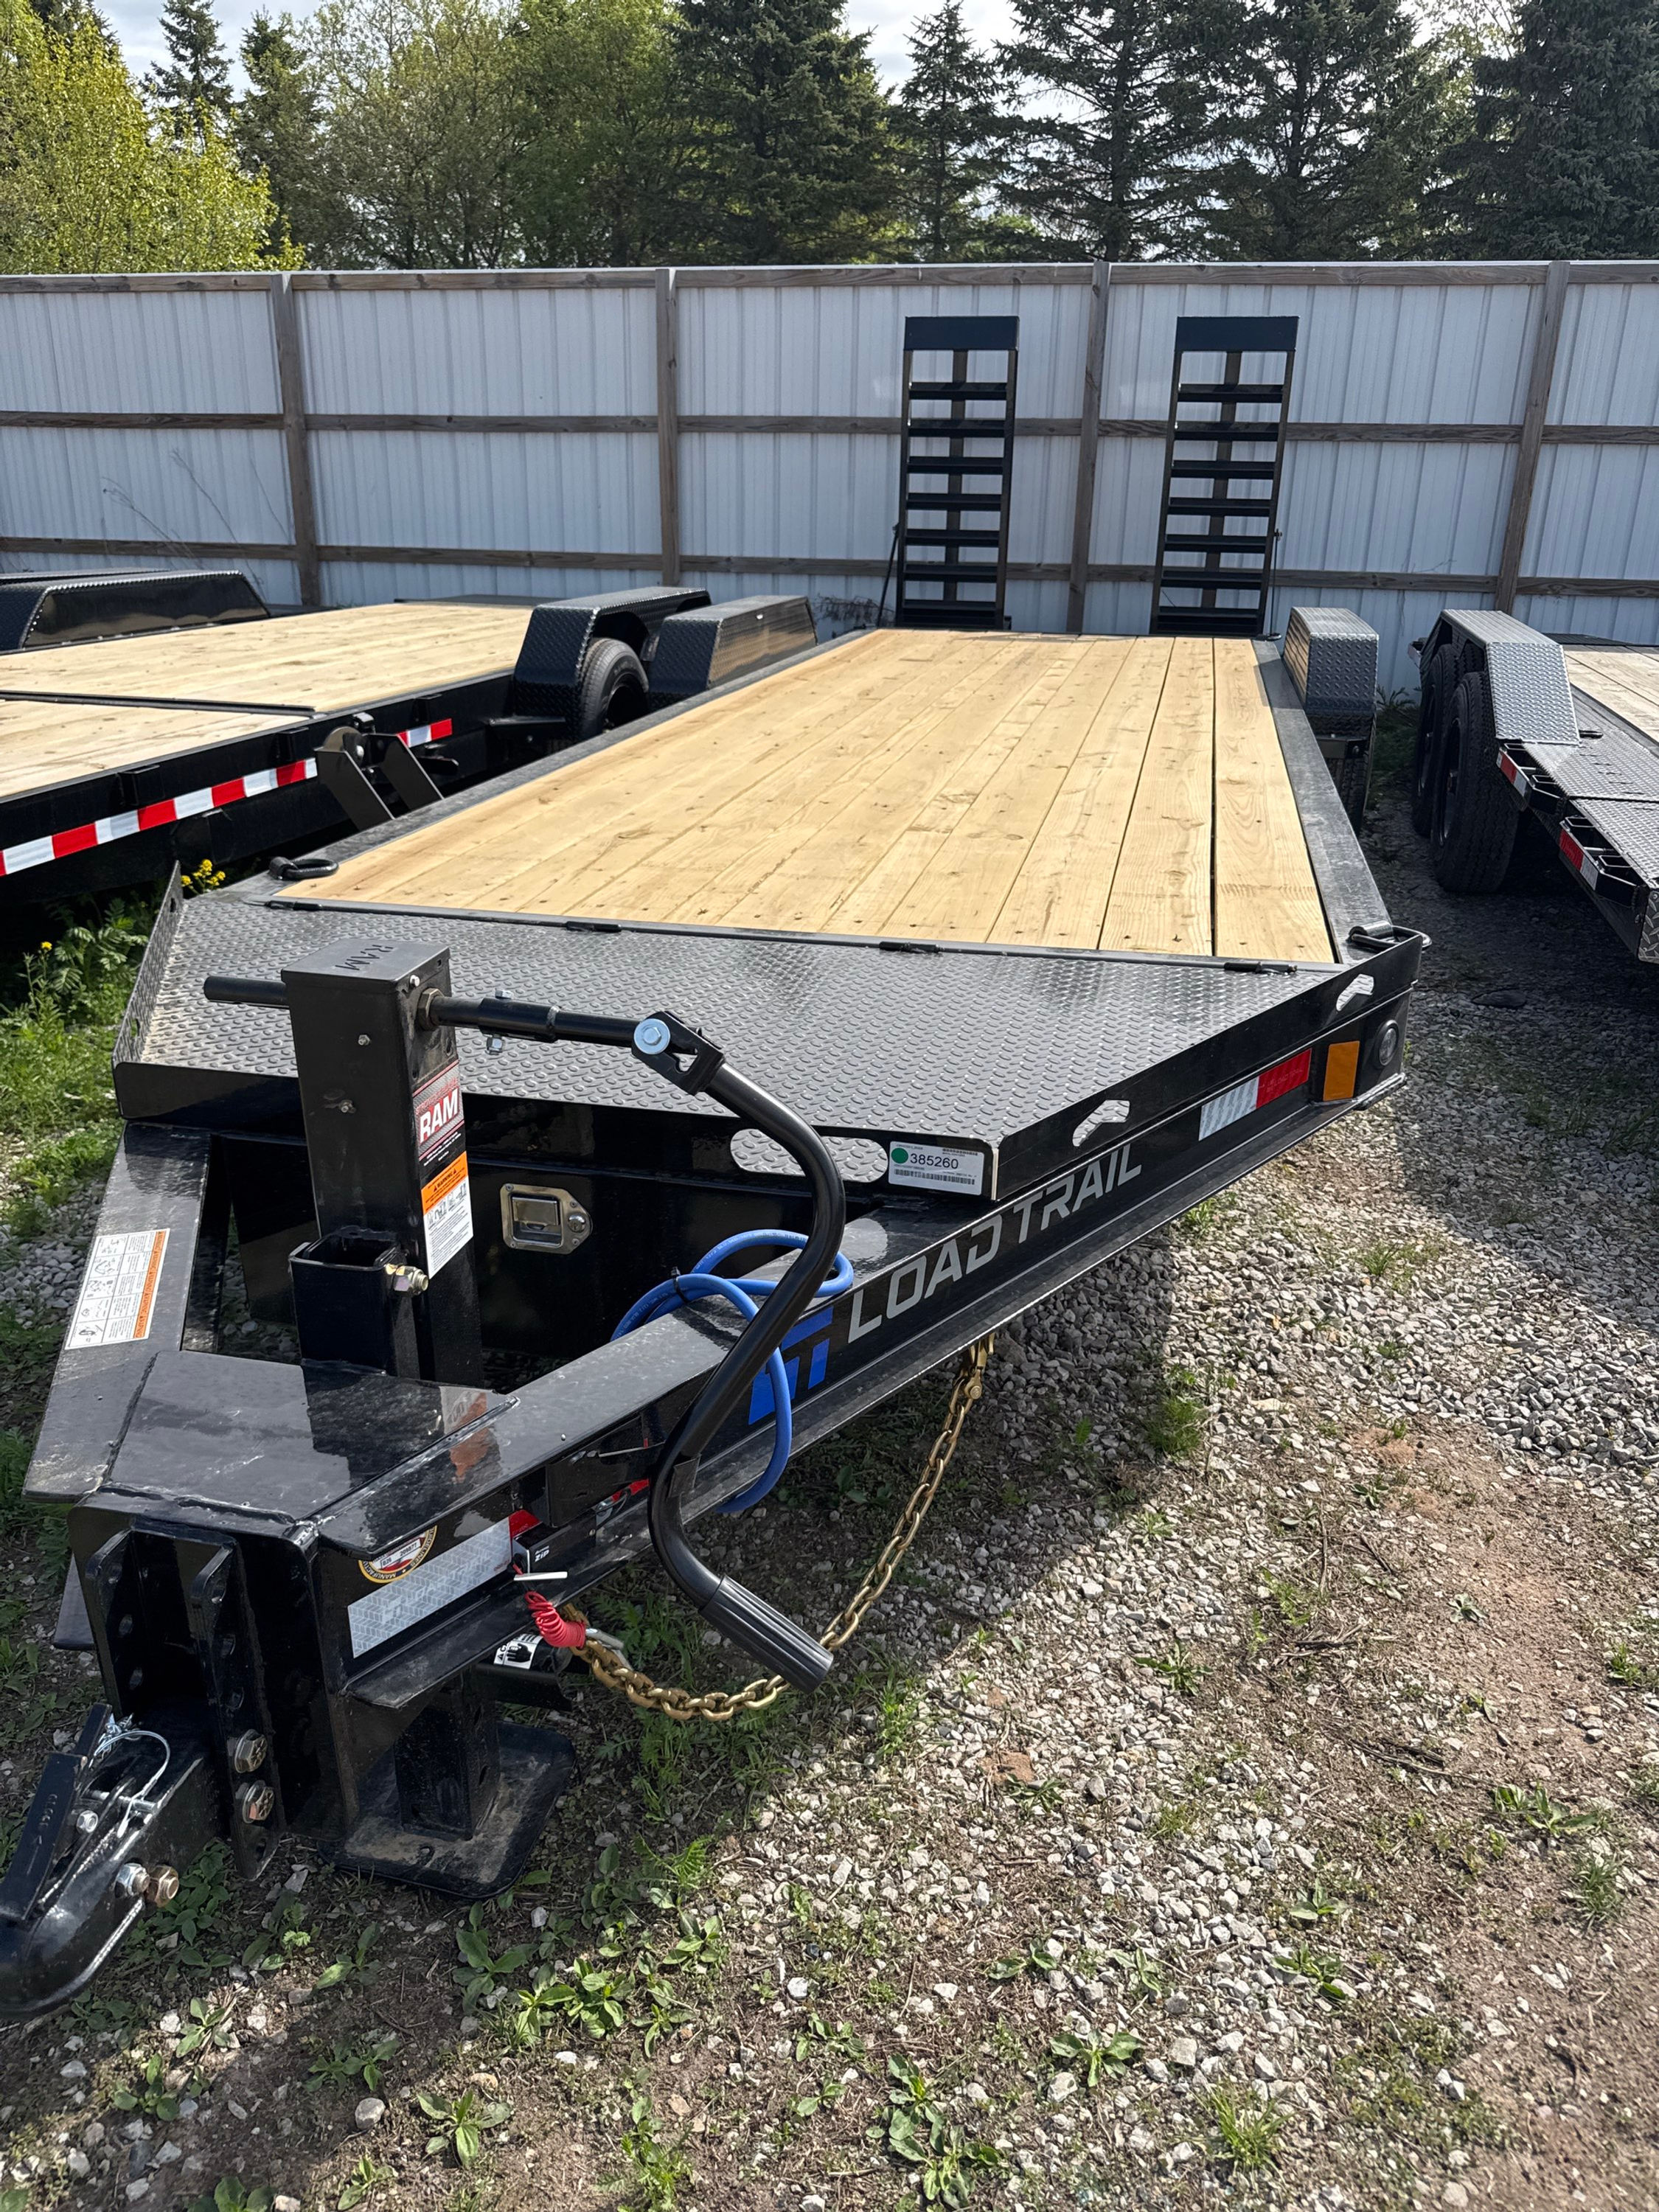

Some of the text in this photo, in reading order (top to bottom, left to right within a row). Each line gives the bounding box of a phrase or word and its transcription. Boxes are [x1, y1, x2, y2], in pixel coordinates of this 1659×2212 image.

[335, 945, 394, 971] RAM
[420, 1088, 459, 1144] RAM
[910, 1152, 959, 1169] 385260
[848, 1144, 1142, 1343] LOAD TRAIL
[363, 1560, 397, 1579] MANUFACTU
